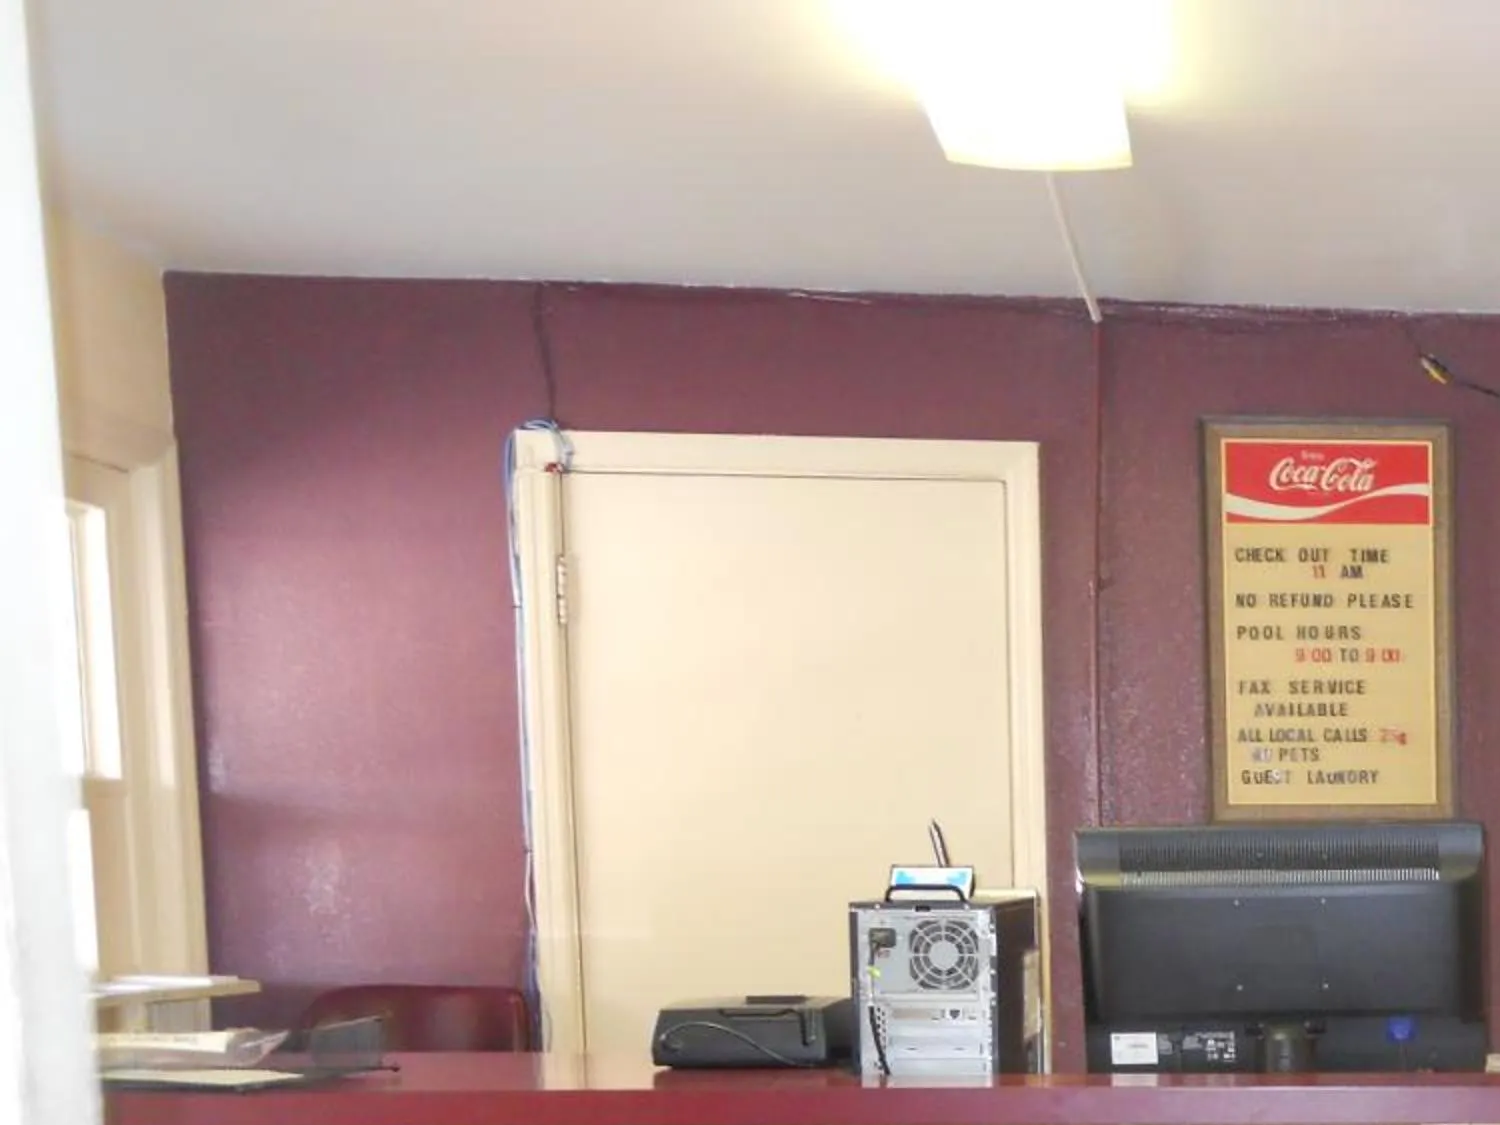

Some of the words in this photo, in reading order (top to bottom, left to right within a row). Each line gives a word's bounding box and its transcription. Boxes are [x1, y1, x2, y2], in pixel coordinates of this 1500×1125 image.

[1269, 456, 1377, 492] Coca-Cola
[1235, 548, 1286, 563] CHECK
[1298, 548, 1330, 563] OUT
[1351, 548, 1389, 563] TIME
[1313, 565, 1325, 578] 11
[1340, 565, 1364, 578] AM
[1235, 593, 1257, 608] NO
[1269, 593, 1333, 608] REFUND
[1347, 593, 1414, 609] PLEASE
[1237, 625, 1284, 640] POOL
[1296, 625, 1362, 640] HOURS
[1340, 648, 1359, 662] TO
[1239, 680, 1271, 694] FAX
[1288, 680, 1367, 694] SERVICE
[1254, 702, 1348, 717] AVAILABLE
[1238, 728, 1262, 743] ALL
[1269, 728, 1315, 743] LOCAL
[1323, 728, 1368, 743] CALLS
[1279, 747, 1320, 762] PETS
[1241, 769, 1291, 784] GUEST
[1307, 769, 1379, 784] LAUNDRY
